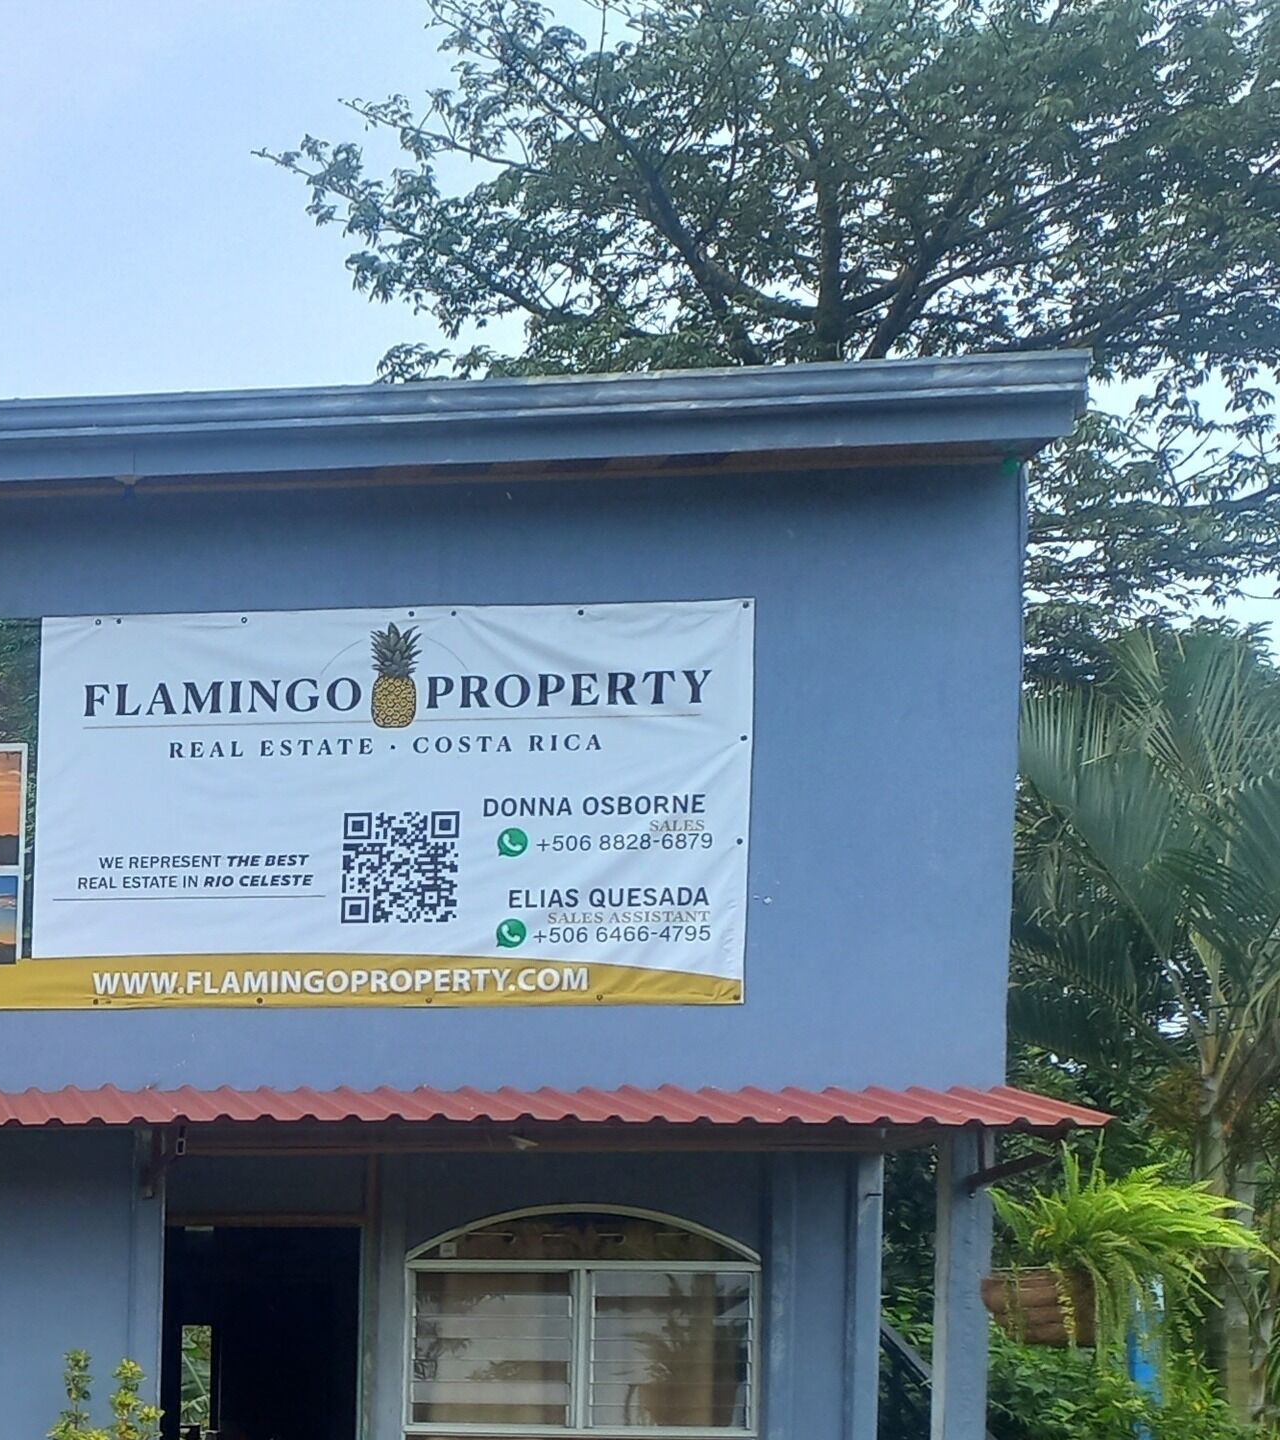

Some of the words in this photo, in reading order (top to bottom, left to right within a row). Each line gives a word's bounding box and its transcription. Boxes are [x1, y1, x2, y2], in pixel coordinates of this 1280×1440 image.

[83, 677, 362, 717] FLAMINGO
[426, 669, 712, 710] PROPERTY
[169, 740, 244, 758] REAL
[260, 738, 374, 757] ESTATE
[413, 735, 512, 755] COSTA
[529, 733, 602, 752] RICA
[483, 797, 571, 817] DONNA
[583, 794, 707, 815] OSBORNE
[649, 819, 706, 833] SALES
[536, 834, 592, 853] +506
[599, 832, 714, 852] 8828-6879
[99, 856, 123, 870] WE
[128, 854, 222, 869] REPRESENT
[227, 854, 260, 868] THE
[265, 854, 310, 867] BEST
[77, 876, 118, 890] REAL
[122, 875, 178, 889] ESTATE
[183, 875, 198, 888] IN
[203, 874, 234, 888] RIO
[239, 874, 314, 887] CELESTE
[508, 889, 579, 909] ELIAS
[589, 886, 710, 909] QUESADA
[547, 911, 603, 925] SALES
[608, 910, 711, 924] ASSISTANT
[533, 926, 589, 944] +506
[596, 925, 711, 943] 6466-4795
[93, 968, 589, 995] WWW.FLAMINGOPROPERTY.COM
